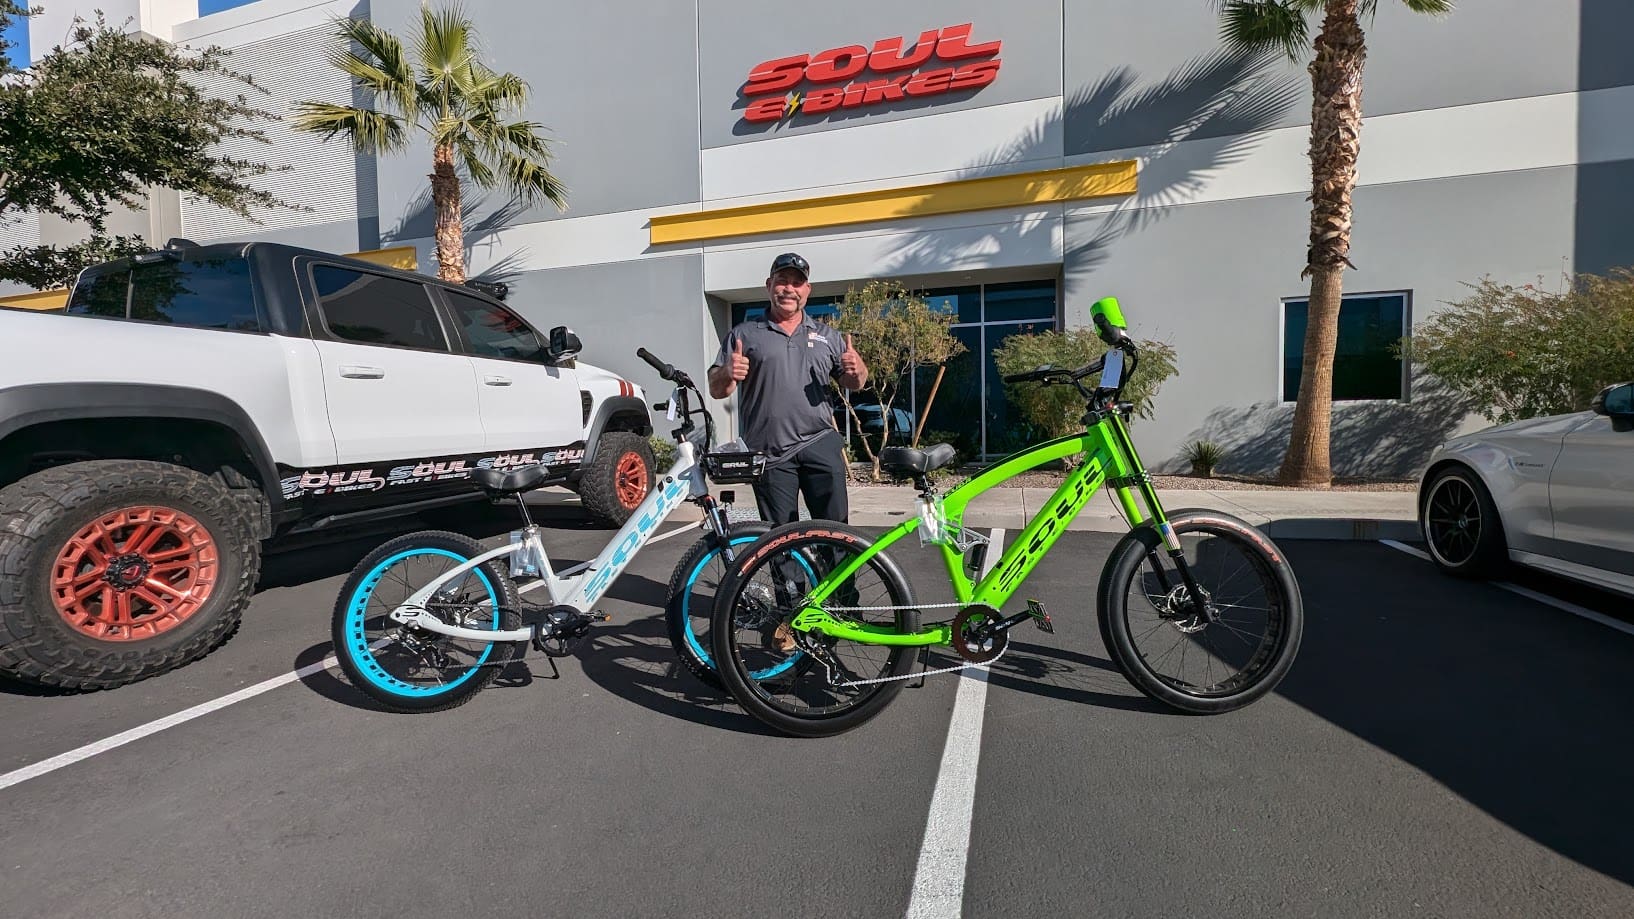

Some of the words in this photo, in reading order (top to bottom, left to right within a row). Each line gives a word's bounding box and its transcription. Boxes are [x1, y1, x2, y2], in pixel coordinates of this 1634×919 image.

[743, 22, 1002, 97] SOUL
[802, 58, 1002, 114] BIKES
[387, 459, 473, 481] SOUL
[477, 453, 540, 468] SOUL
[541, 449, 584, 464] SOU
[280, 469, 386, 494] SOUL
[584, 479, 689, 604] SOUL
[999, 463, 1102, 593] SOUL
